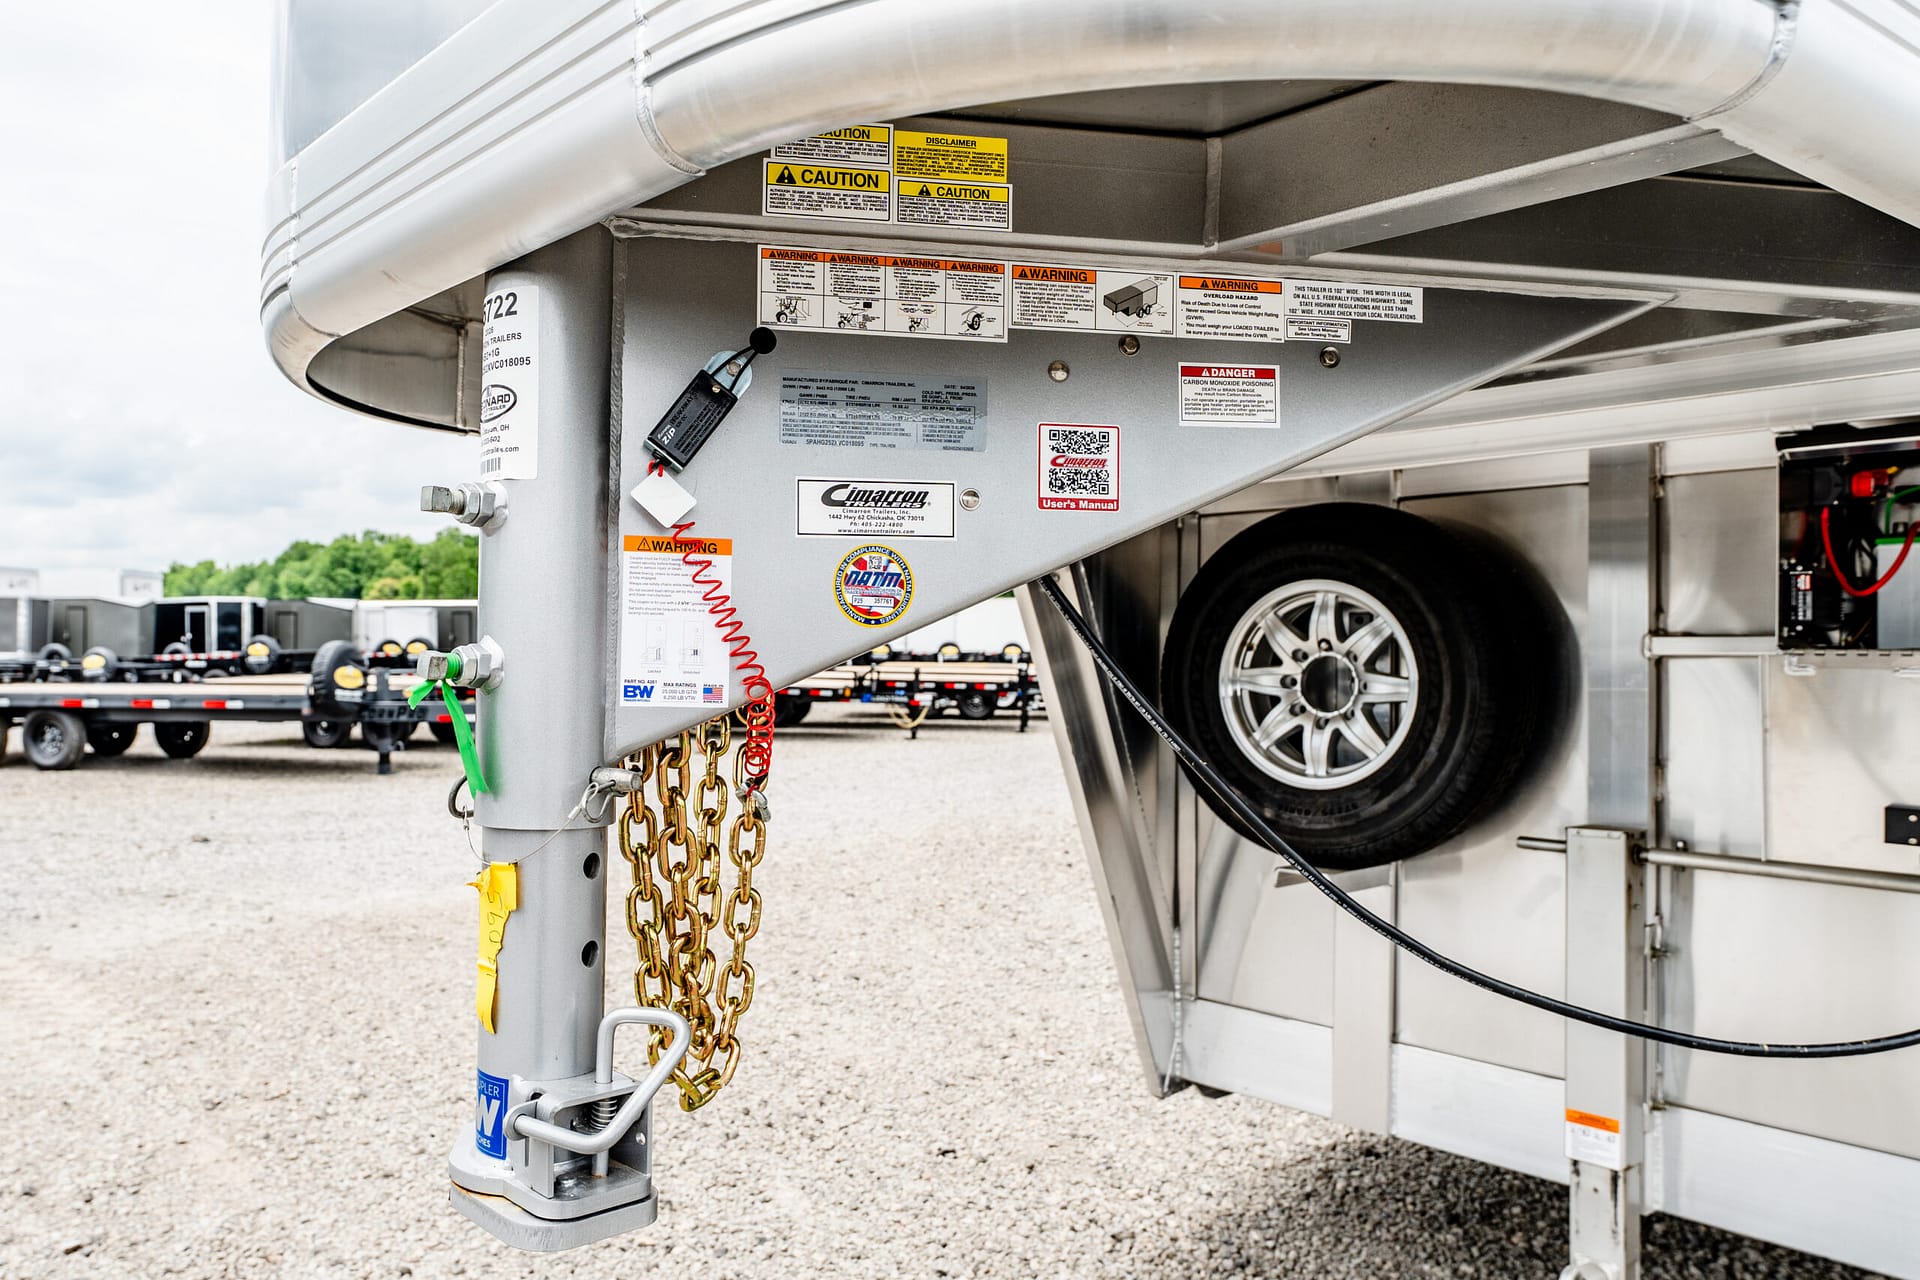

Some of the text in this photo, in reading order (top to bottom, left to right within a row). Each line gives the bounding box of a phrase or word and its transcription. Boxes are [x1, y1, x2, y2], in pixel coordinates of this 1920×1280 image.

[819, 128, 870, 139] AUTION
[926, 137, 976, 147] DISCLAIMER
[801, 169, 879, 188] CAUTION
[937, 187, 990, 199] CAUTION
[777, 251, 818, 260] WARNING
[838, 255, 878, 264] WARNING
[900, 259, 940, 269] WARNING
[959, 263, 998, 272] WARNING
[1030, 269, 1087, 281] WARNING
[1212, 280, 1258, 290] WARNING
[491, 332, 521, 344] TRAILERS
[1211, 369, 1255, 377] DANGER
[1051, 455, 1107, 468] Cimarron
[821, 484, 929, 507] Cimarron
[1043, 499, 1117, 510] User's Manual
[846, 547, 890, 562] COMPLIANCE
[891, 552, 905, 570] WITH
[904, 569, 912, 593] NATM
[836, 572, 865, 623] MANUFACTURED
[880, 593, 911, 623] GUIDELINES
